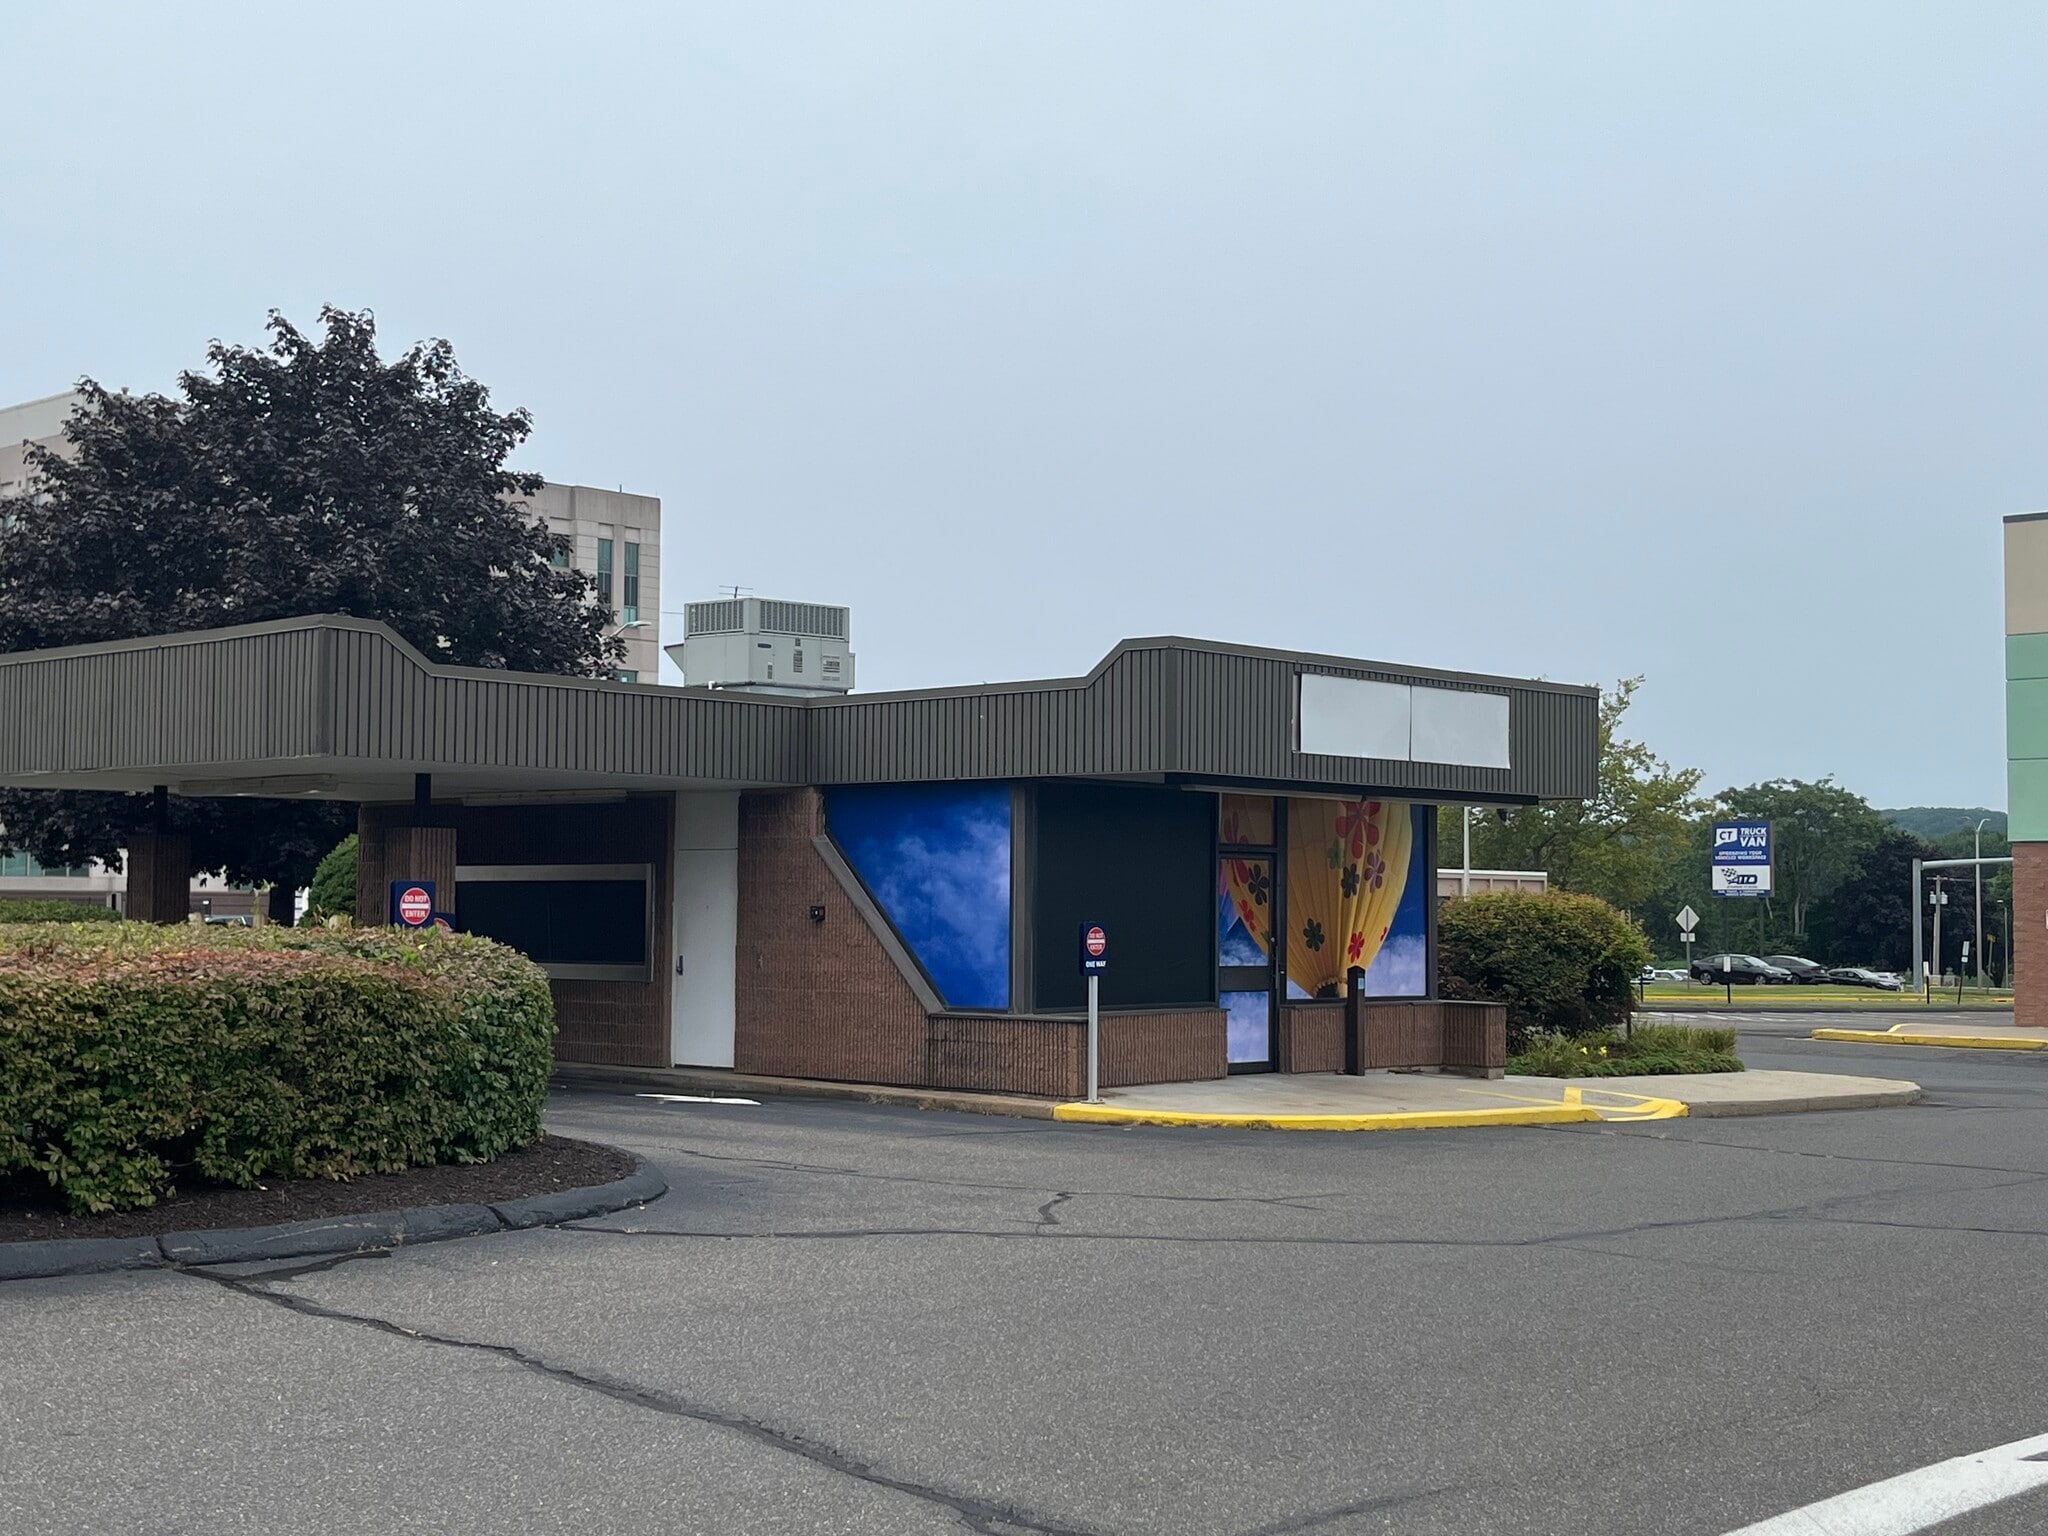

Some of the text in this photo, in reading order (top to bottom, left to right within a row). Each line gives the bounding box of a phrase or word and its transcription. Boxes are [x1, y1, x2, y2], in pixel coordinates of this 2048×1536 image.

[1740, 827, 1767, 835] TRUCK
[1720, 831, 1733, 840] CT
[1740, 837, 1766, 847] VAN
[405, 910, 425, 918] ENTER
